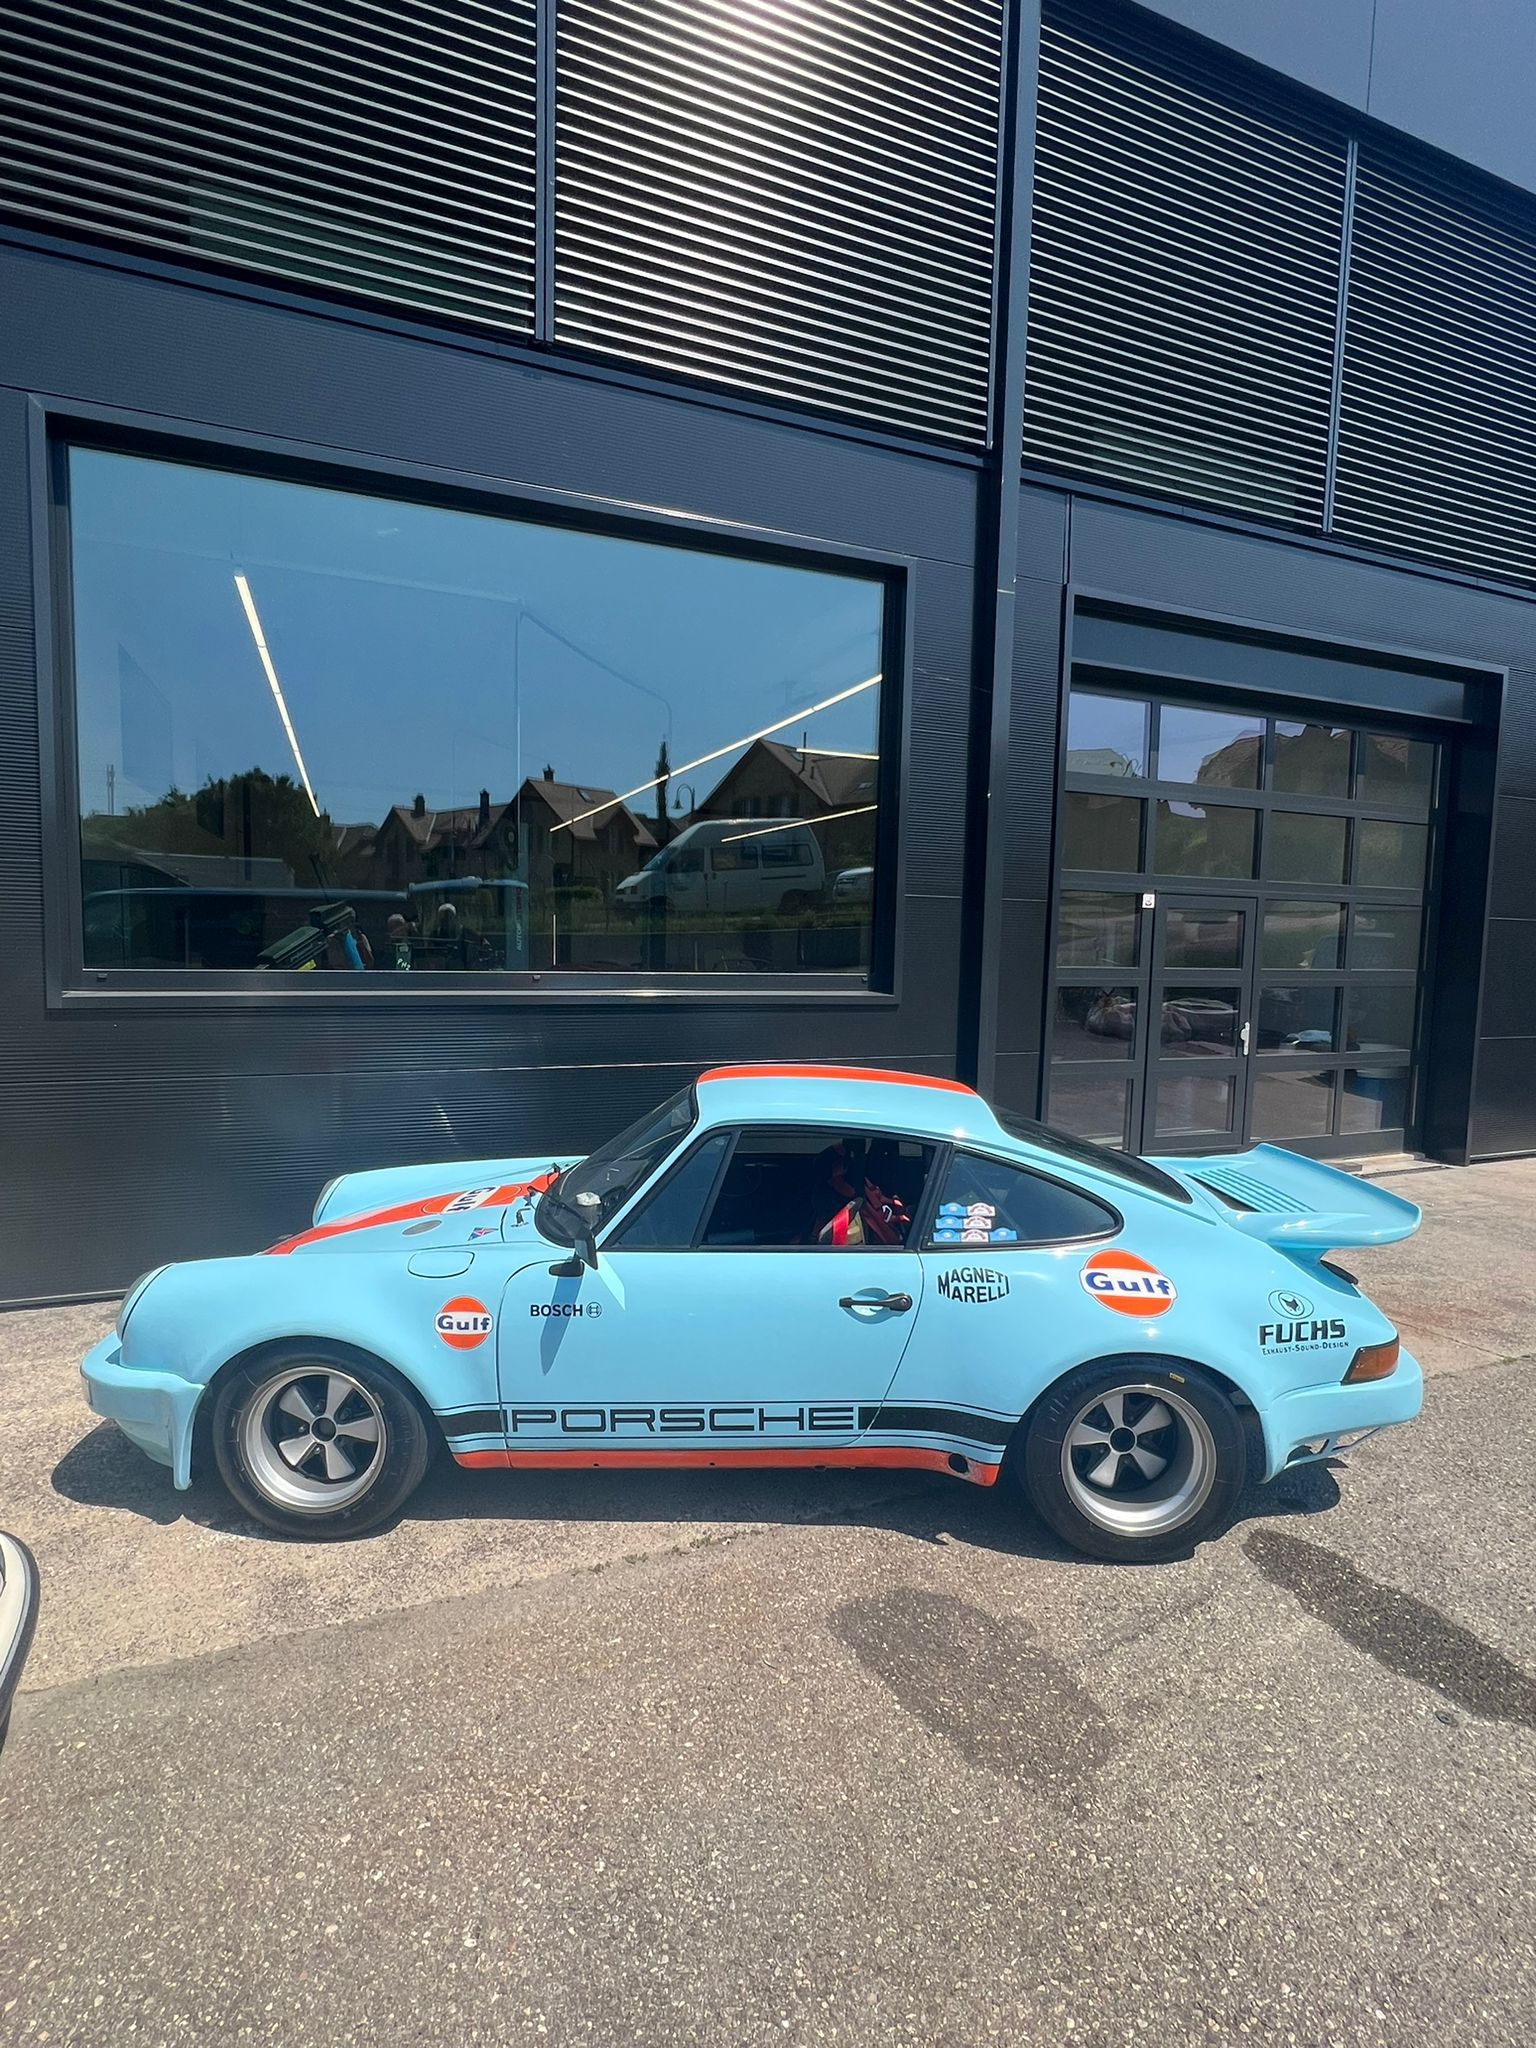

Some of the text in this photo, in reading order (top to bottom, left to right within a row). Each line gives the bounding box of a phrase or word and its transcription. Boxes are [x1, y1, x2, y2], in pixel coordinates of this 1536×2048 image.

[937, 1267, 1010, 1292] MAGNETI
[937, 1279, 1010, 1304] MARELLI
[1085, 1271, 1170, 1296] Gulf
[437, 1314, 491, 1331] Gulf
[530, 1304, 584, 1317] BOSCH
[1259, 1318, 1346, 1346] FUCHS
[511, 1407, 854, 1432] PORSCHE
